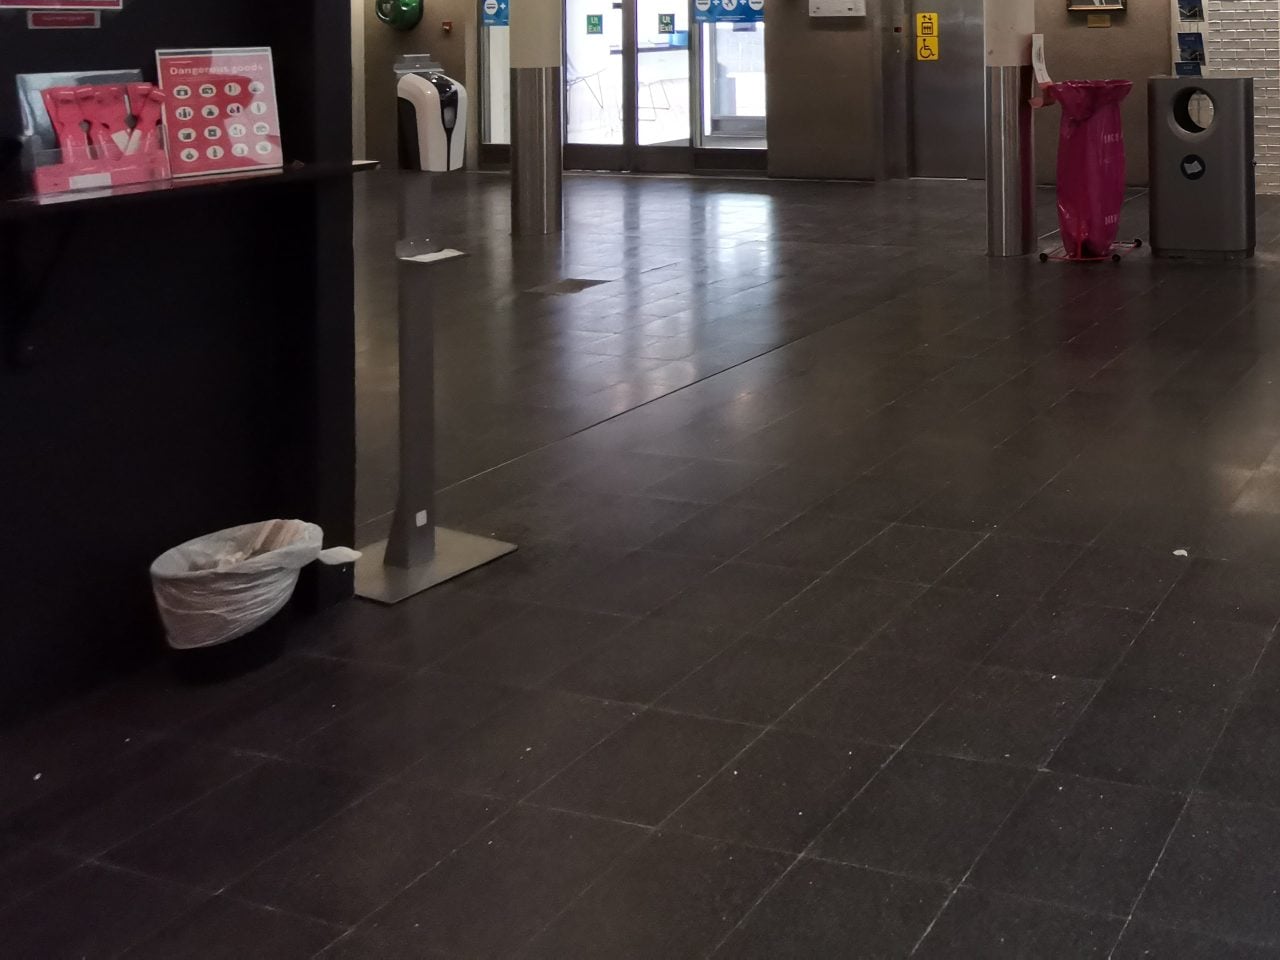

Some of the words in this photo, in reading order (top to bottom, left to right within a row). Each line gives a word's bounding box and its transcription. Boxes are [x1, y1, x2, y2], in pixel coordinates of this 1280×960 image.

[662, 16, 671, 24] Ut
[169, 65, 229, 76] Dangerous
[231, 63, 263, 75] goods
